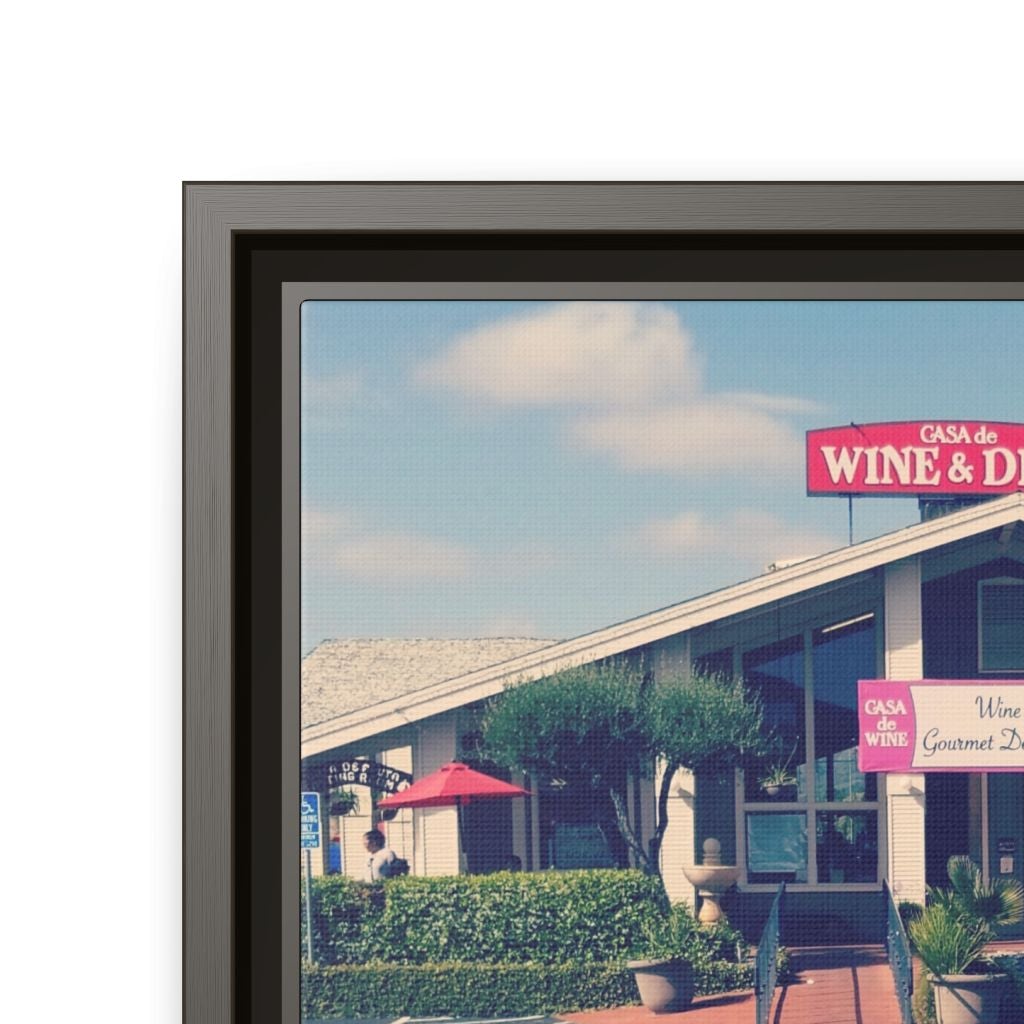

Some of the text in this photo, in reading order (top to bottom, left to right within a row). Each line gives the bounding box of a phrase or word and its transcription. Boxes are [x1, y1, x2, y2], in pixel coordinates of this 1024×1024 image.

[919, 424, 998, 445] CASA de
[821, 445, 942, 486] WINE
[947, 452, 974, 484] &
[864, 699, 908, 716] CASA
[974, 695, 1021, 719] Wine
[876, 716, 898, 732] de
[864, 731, 909, 747] WINE
[922, 727, 994, 757] Gourmet
